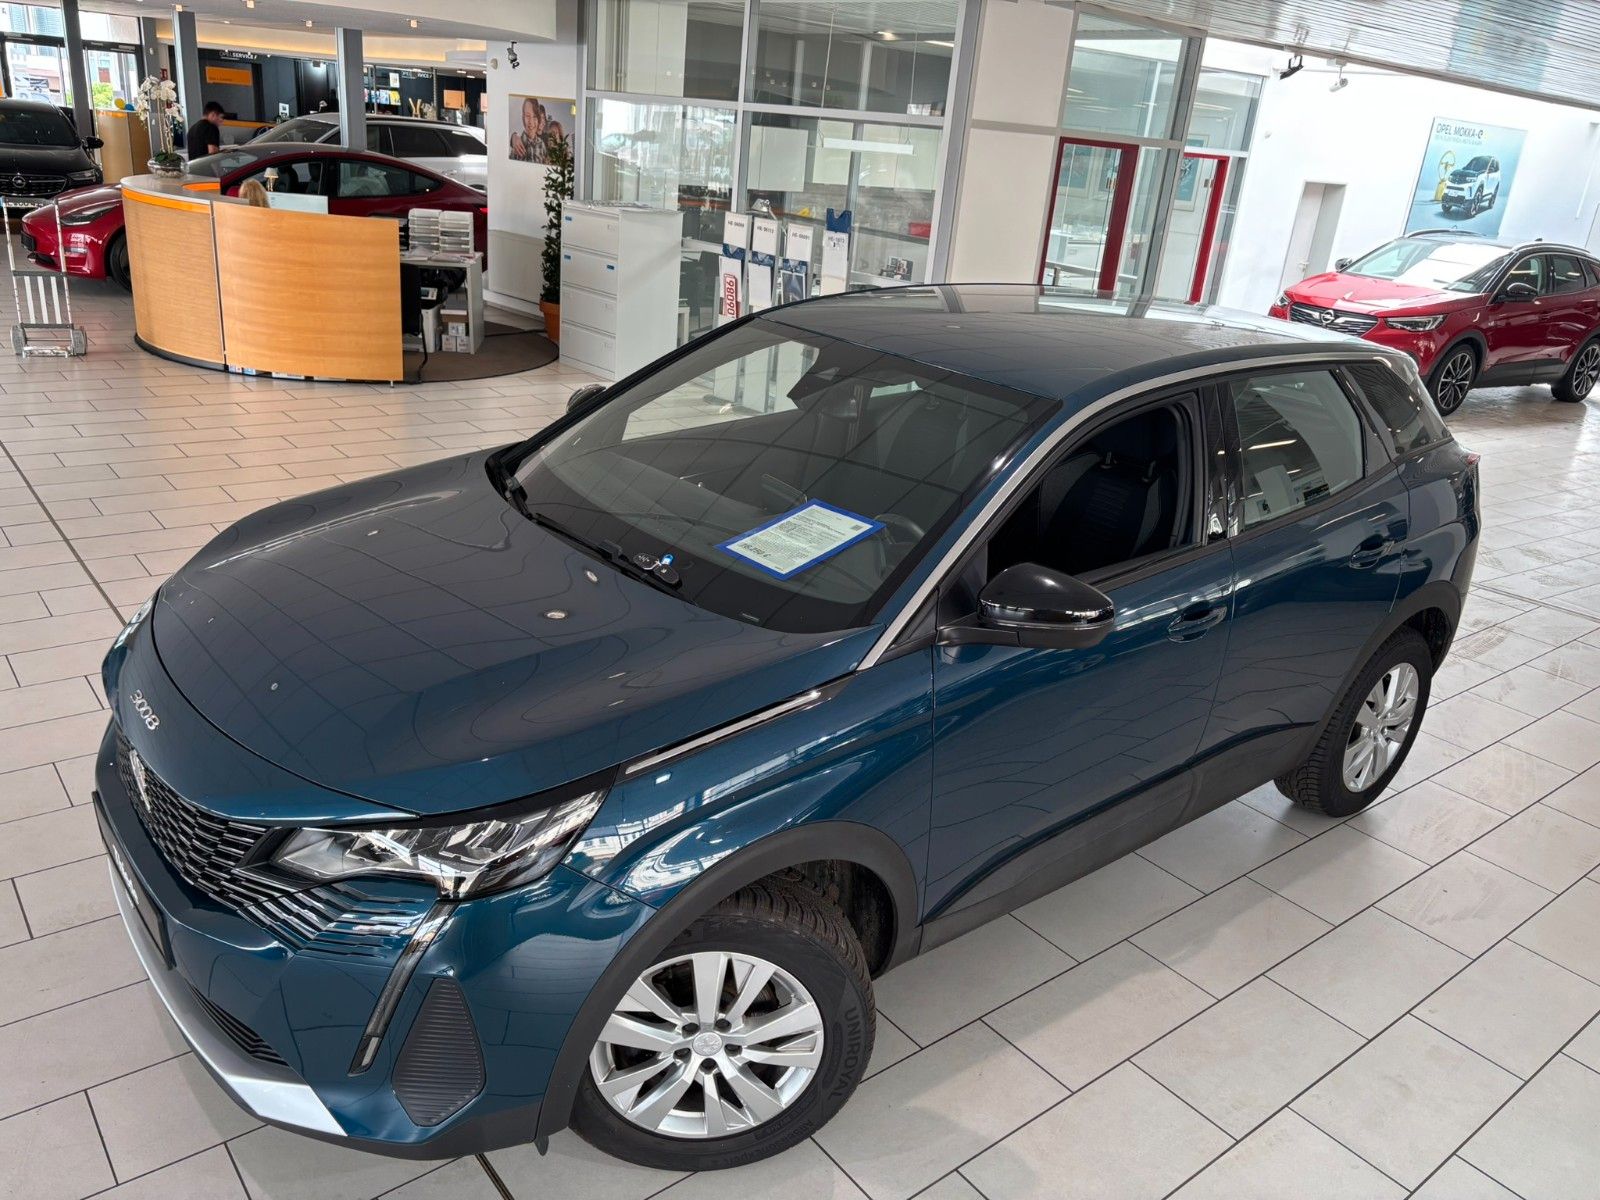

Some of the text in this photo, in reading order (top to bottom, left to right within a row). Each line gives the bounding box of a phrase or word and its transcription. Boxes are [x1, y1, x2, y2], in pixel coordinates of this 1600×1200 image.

[1436, 123, 1452, 135] OPEL
[130, 689, 160, 730] 3008
[828, 1006, 861, 1100] UNIROYAL
